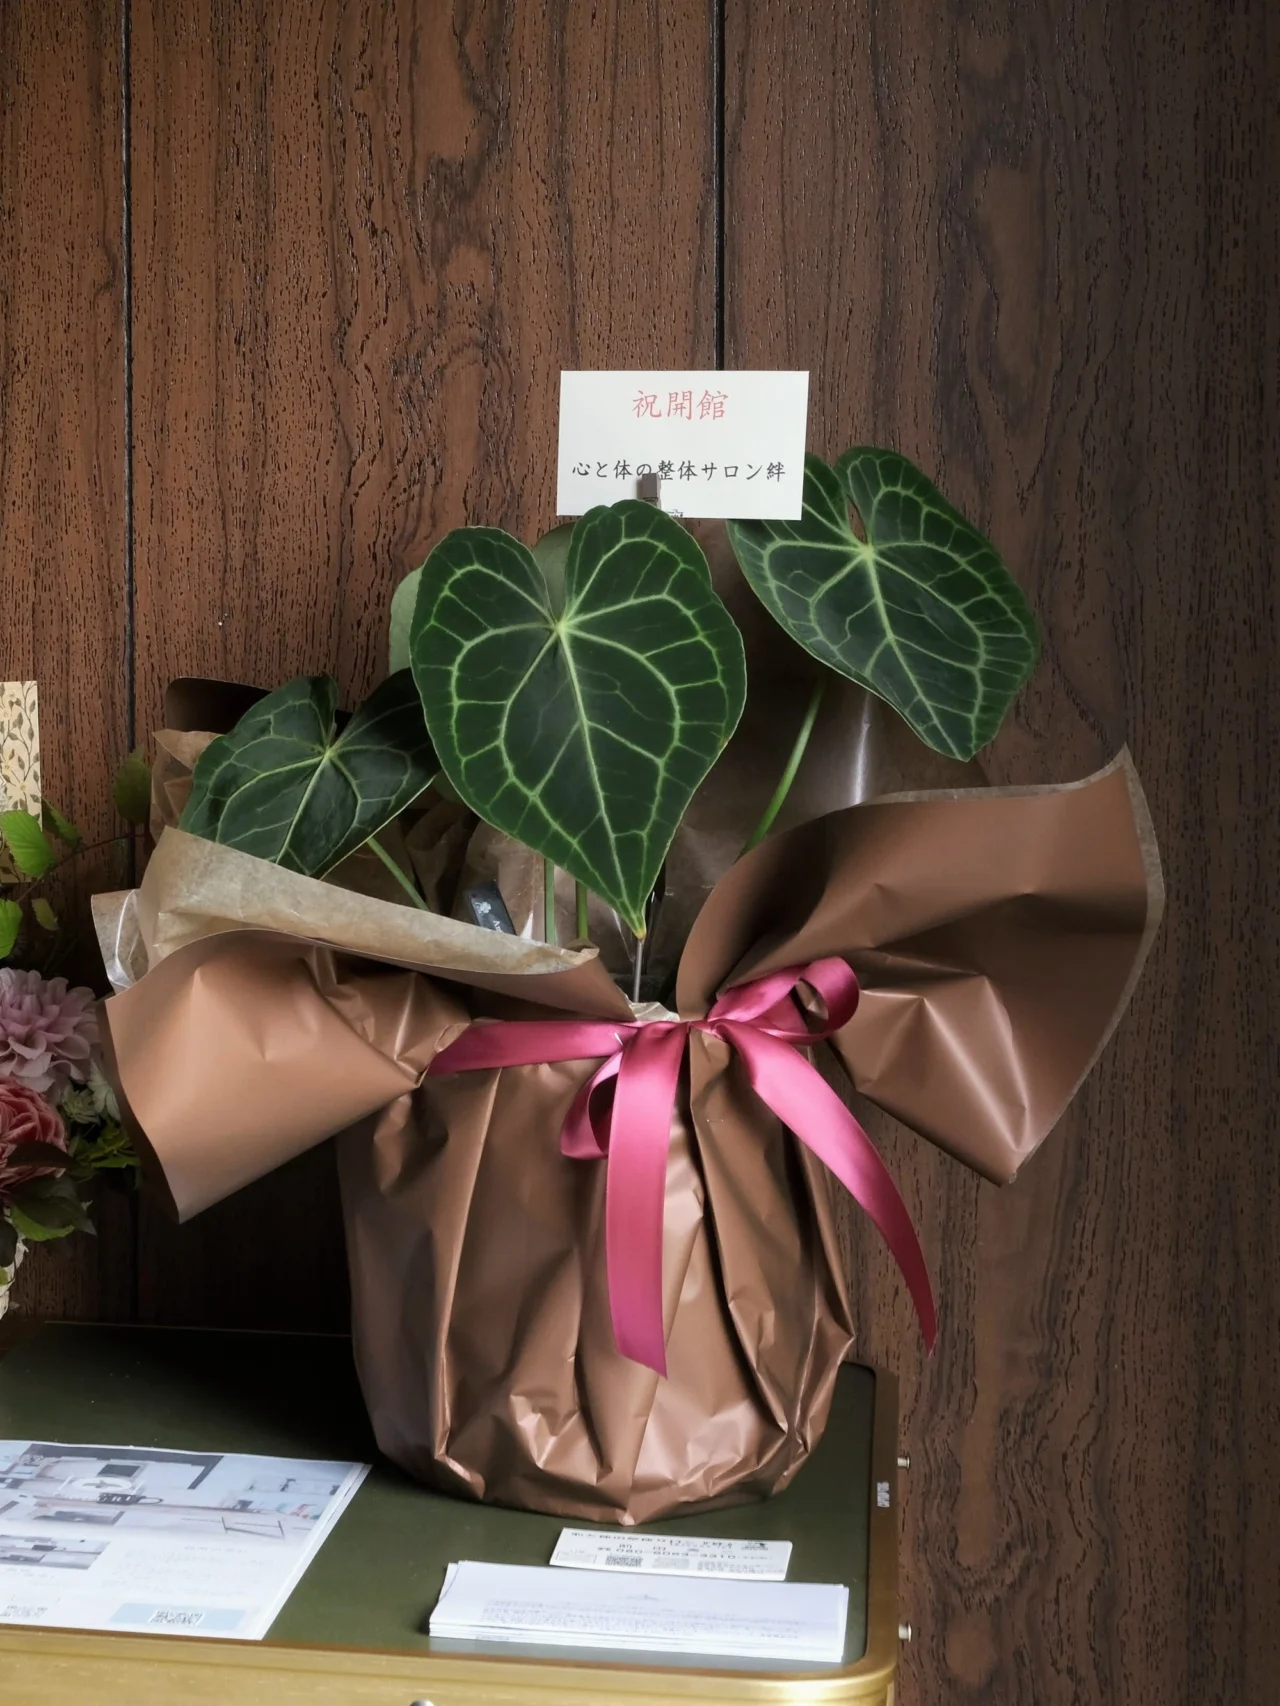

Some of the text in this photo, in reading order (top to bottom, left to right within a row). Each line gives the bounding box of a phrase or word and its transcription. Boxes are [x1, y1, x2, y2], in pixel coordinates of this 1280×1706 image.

[631, 389, 729, 420] 祝開館
[572, 459, 786, 482] 心と体の整体サロン絆
